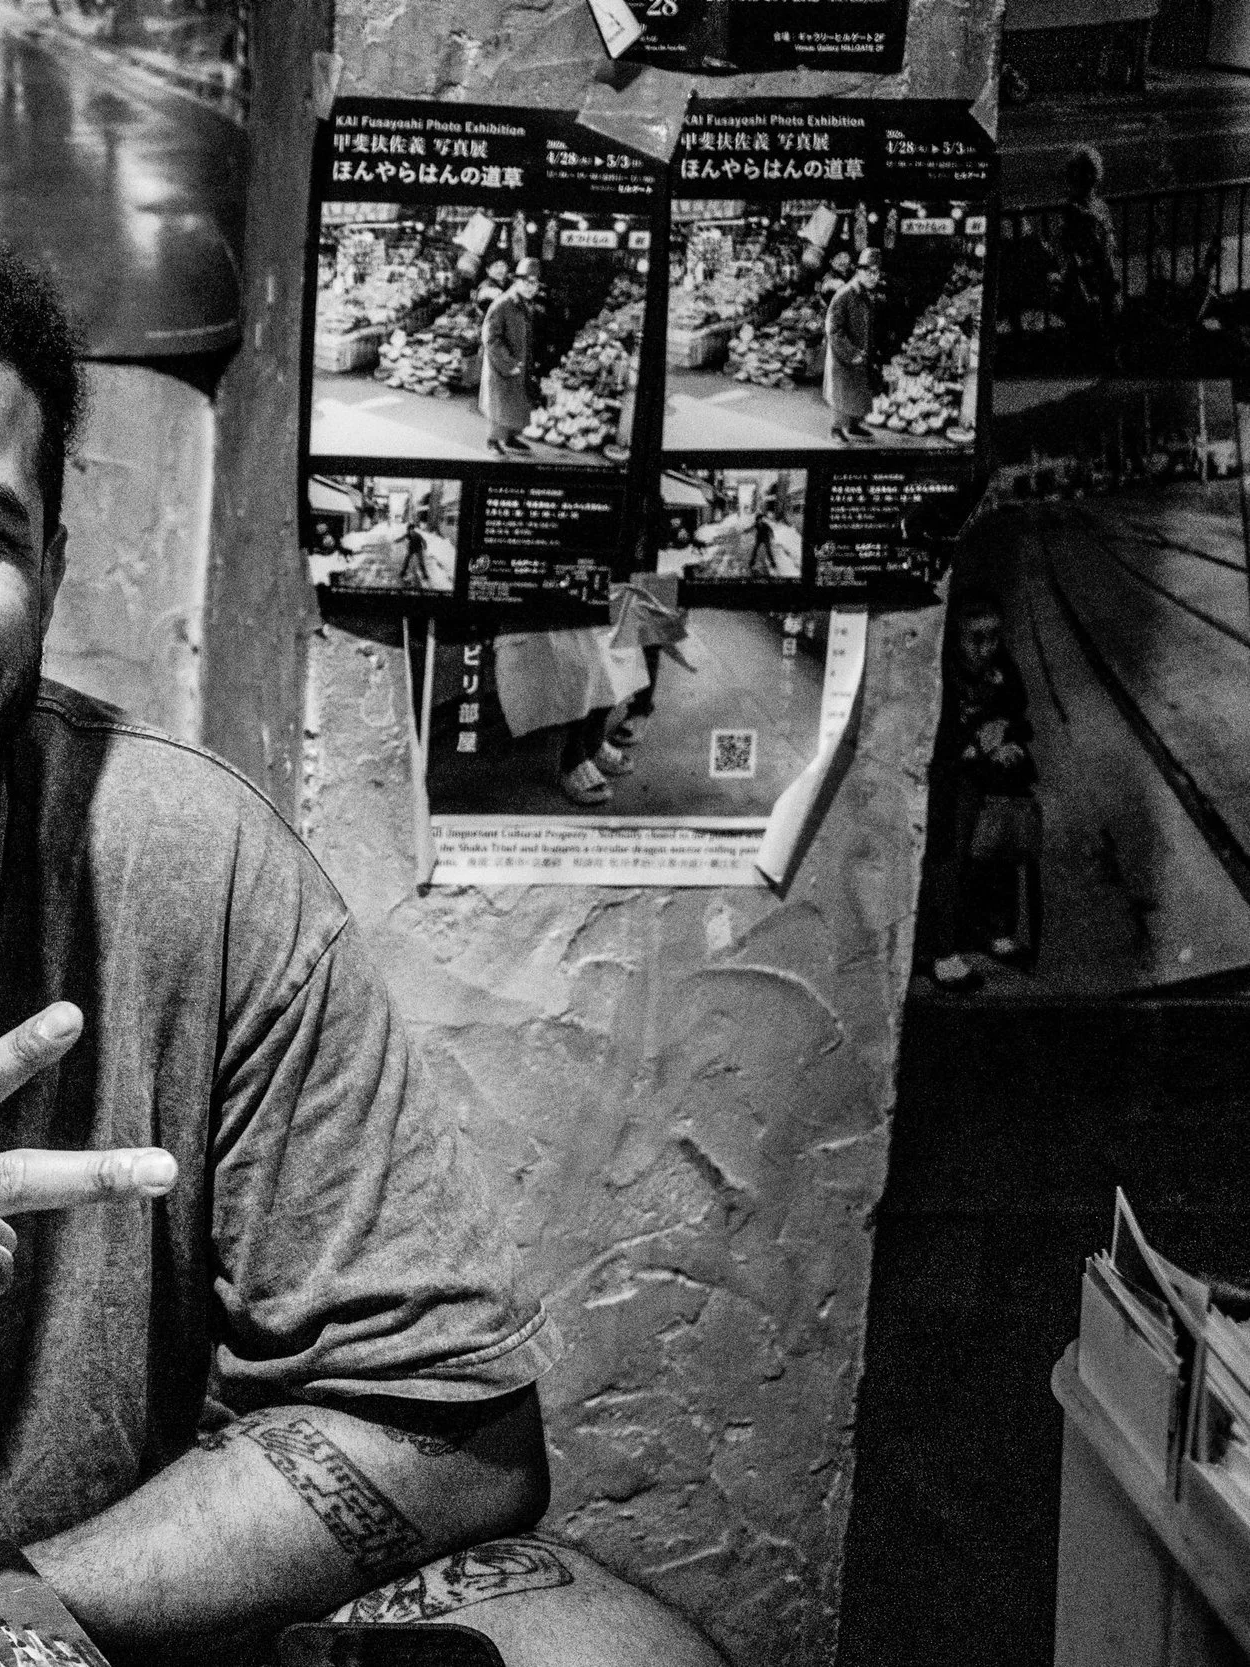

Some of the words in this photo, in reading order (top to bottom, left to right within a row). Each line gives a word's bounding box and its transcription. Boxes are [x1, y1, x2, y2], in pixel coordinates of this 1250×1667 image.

[335, 115, 358, 127] KAI
[361, 115, 424, 131] Fusayoshi
[426, 118, 462, 133] Photo
[465, 121, 527, 137] Exhibition
[706, 113, 767, 128] Fusayoshi
[770, 114, 804, 127] Photo
[807, 114, 865, 127] Exhibition
[433, 137, 488, 159] 写真展
[777, 132, 830, 152] 写真展
[333, 160, 524, 189] ほんやらはんの道草
[680, 157, 865, 180] ほんやらはんの道草
